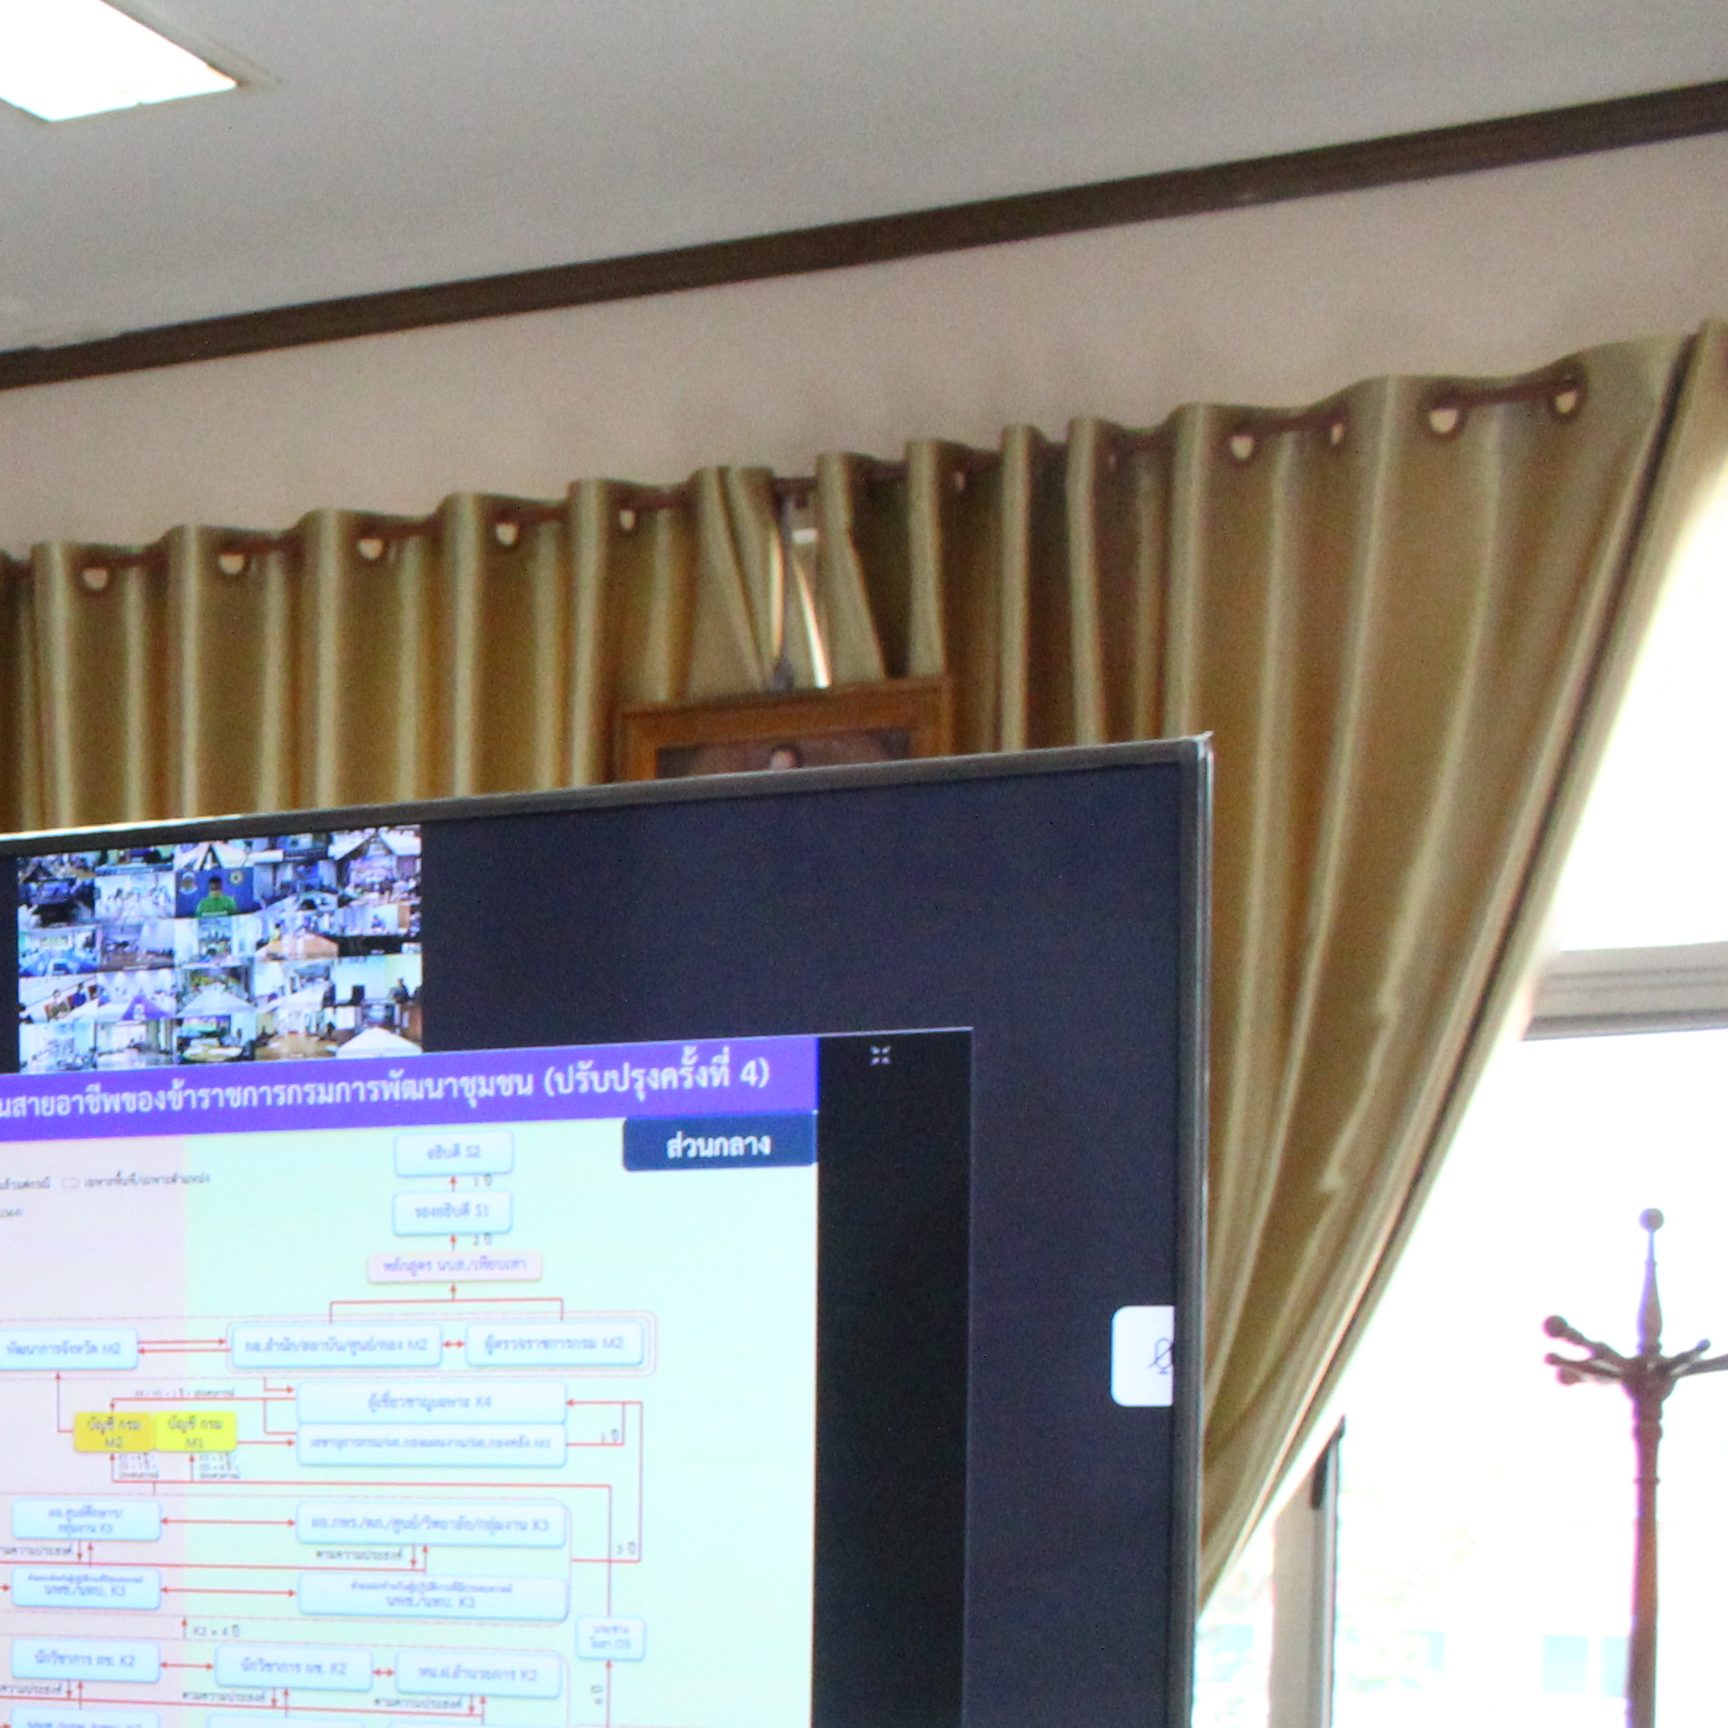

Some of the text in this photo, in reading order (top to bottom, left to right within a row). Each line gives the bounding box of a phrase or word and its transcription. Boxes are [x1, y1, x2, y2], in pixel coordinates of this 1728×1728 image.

[543, 1045, 731, 1103] (ปรับปรุงครั้งที่
[740, 1056, 770, 1091] 4)
[666, 1129, 772, 1160] ส่วนกลาง
